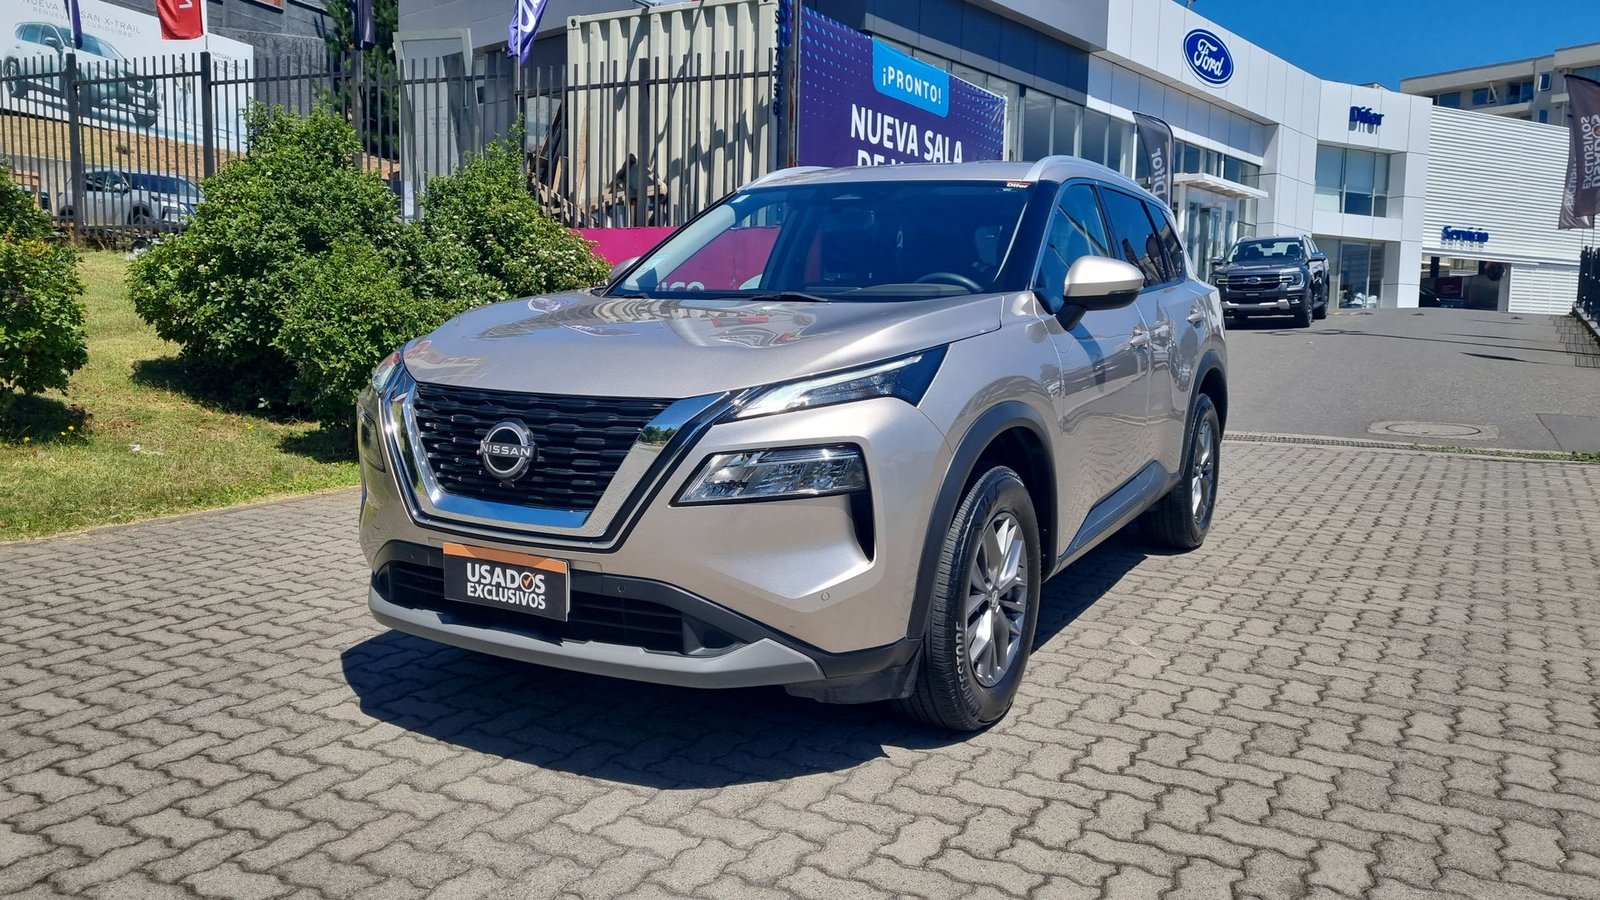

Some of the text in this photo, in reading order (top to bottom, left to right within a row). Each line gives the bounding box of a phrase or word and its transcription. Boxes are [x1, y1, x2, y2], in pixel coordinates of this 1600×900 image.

[104, 17, 141, 34] X-TRAIL
[1193, 38, 1224, 77] Ford
[882, 65, 942, 104] ¡PRONTO!
[850, 103, 963, 164] NUEVA SALA
[480, 442, 531, 458] NISSAN
[466, 562, 546, 594] USADOS
[466, 582, 546, 610] EXCLUSIVOS
